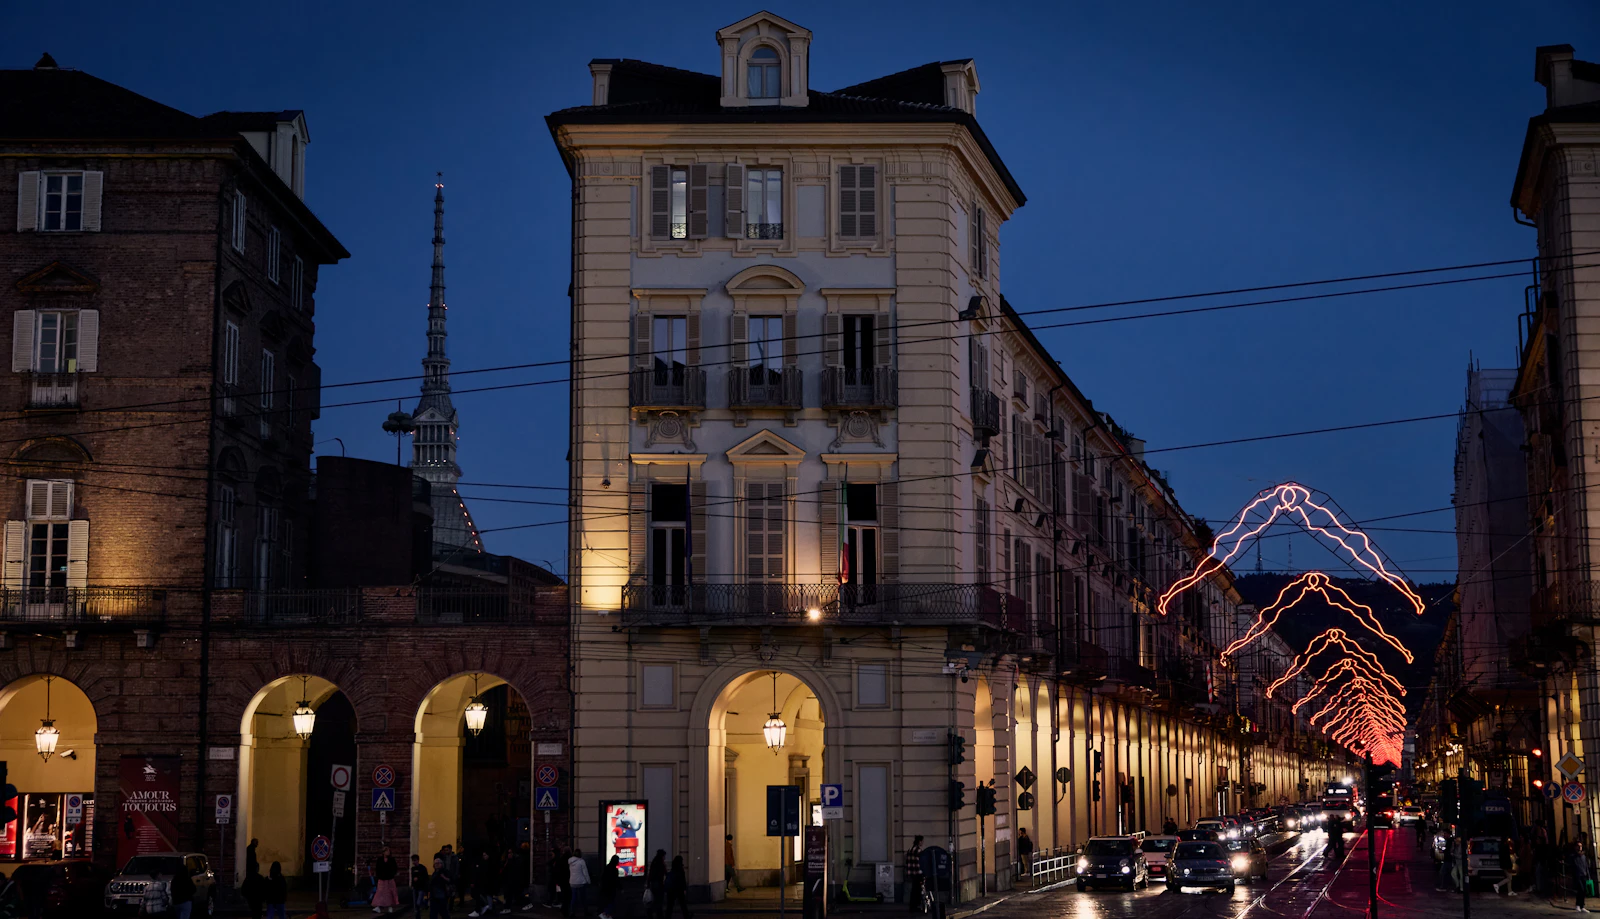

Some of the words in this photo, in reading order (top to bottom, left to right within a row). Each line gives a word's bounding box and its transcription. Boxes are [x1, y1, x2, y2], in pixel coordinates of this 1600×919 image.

[129, 791, 170, 799] AMOUR
[825, 786, 839, 805] P
[123, 803, 177, 812] TOUJOURS
